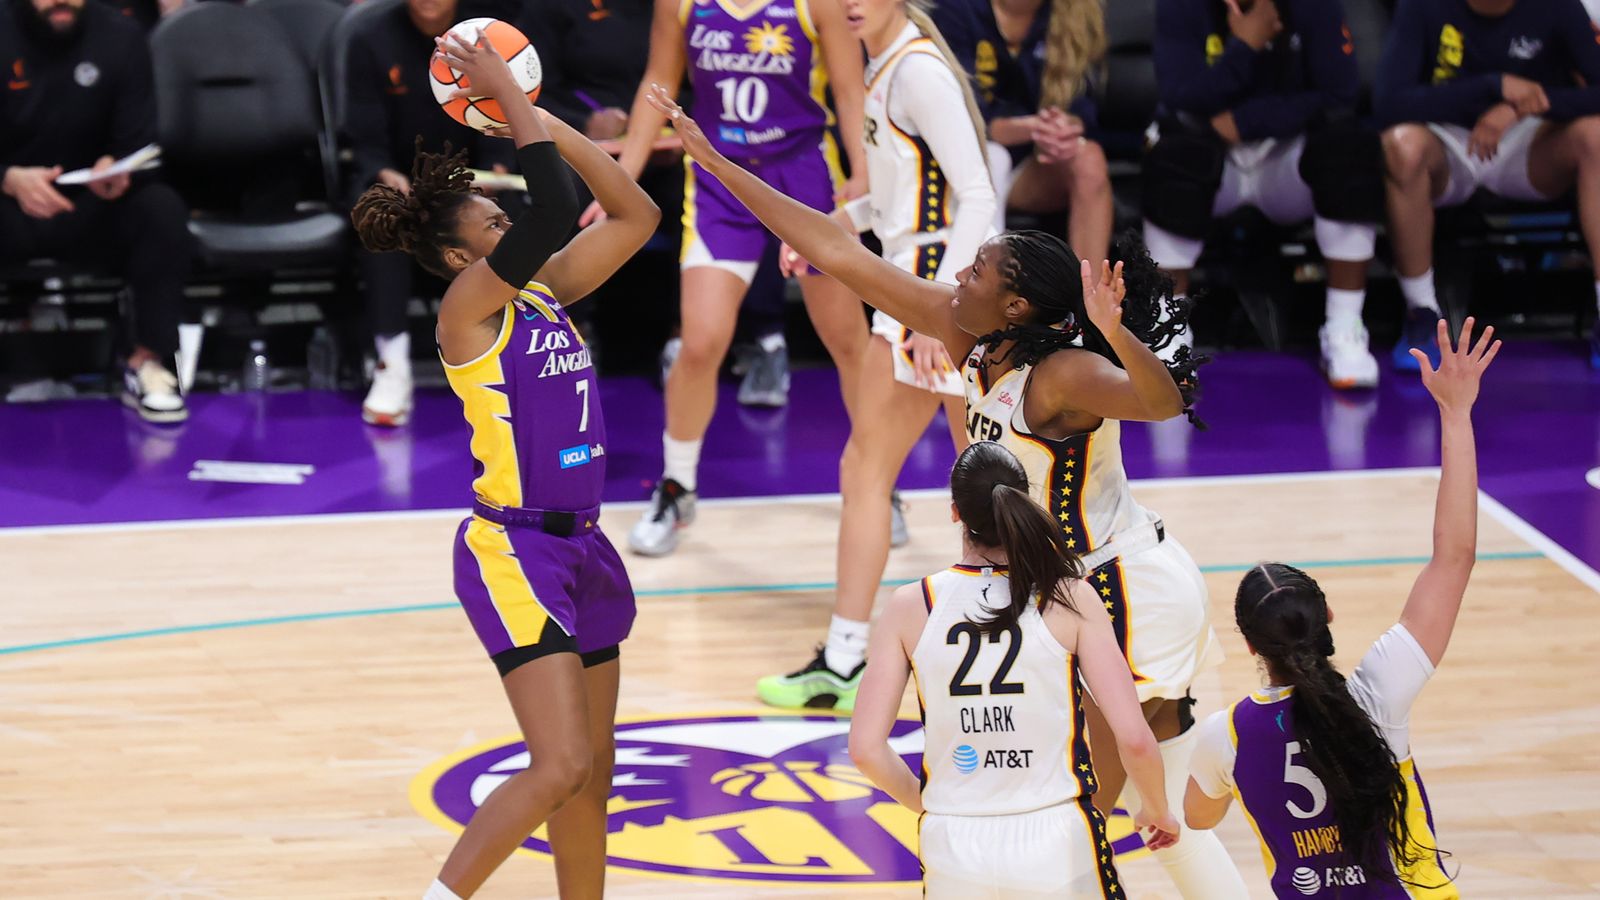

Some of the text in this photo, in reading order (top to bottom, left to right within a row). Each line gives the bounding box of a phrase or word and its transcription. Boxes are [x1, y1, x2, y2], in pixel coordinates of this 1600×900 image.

[715, 76, 769, 123] 10
[576, 379, 589, 432] 7
[966, 403, 1003, 442] VER
[563, 450, 587, 465] UCLA
[946, 621, 1025, 696] 22
[960, 705, 1015, 734] CLARK
[984, 749, 1034, 769] AT&T
[1284, 740, 1328, 819] 5
